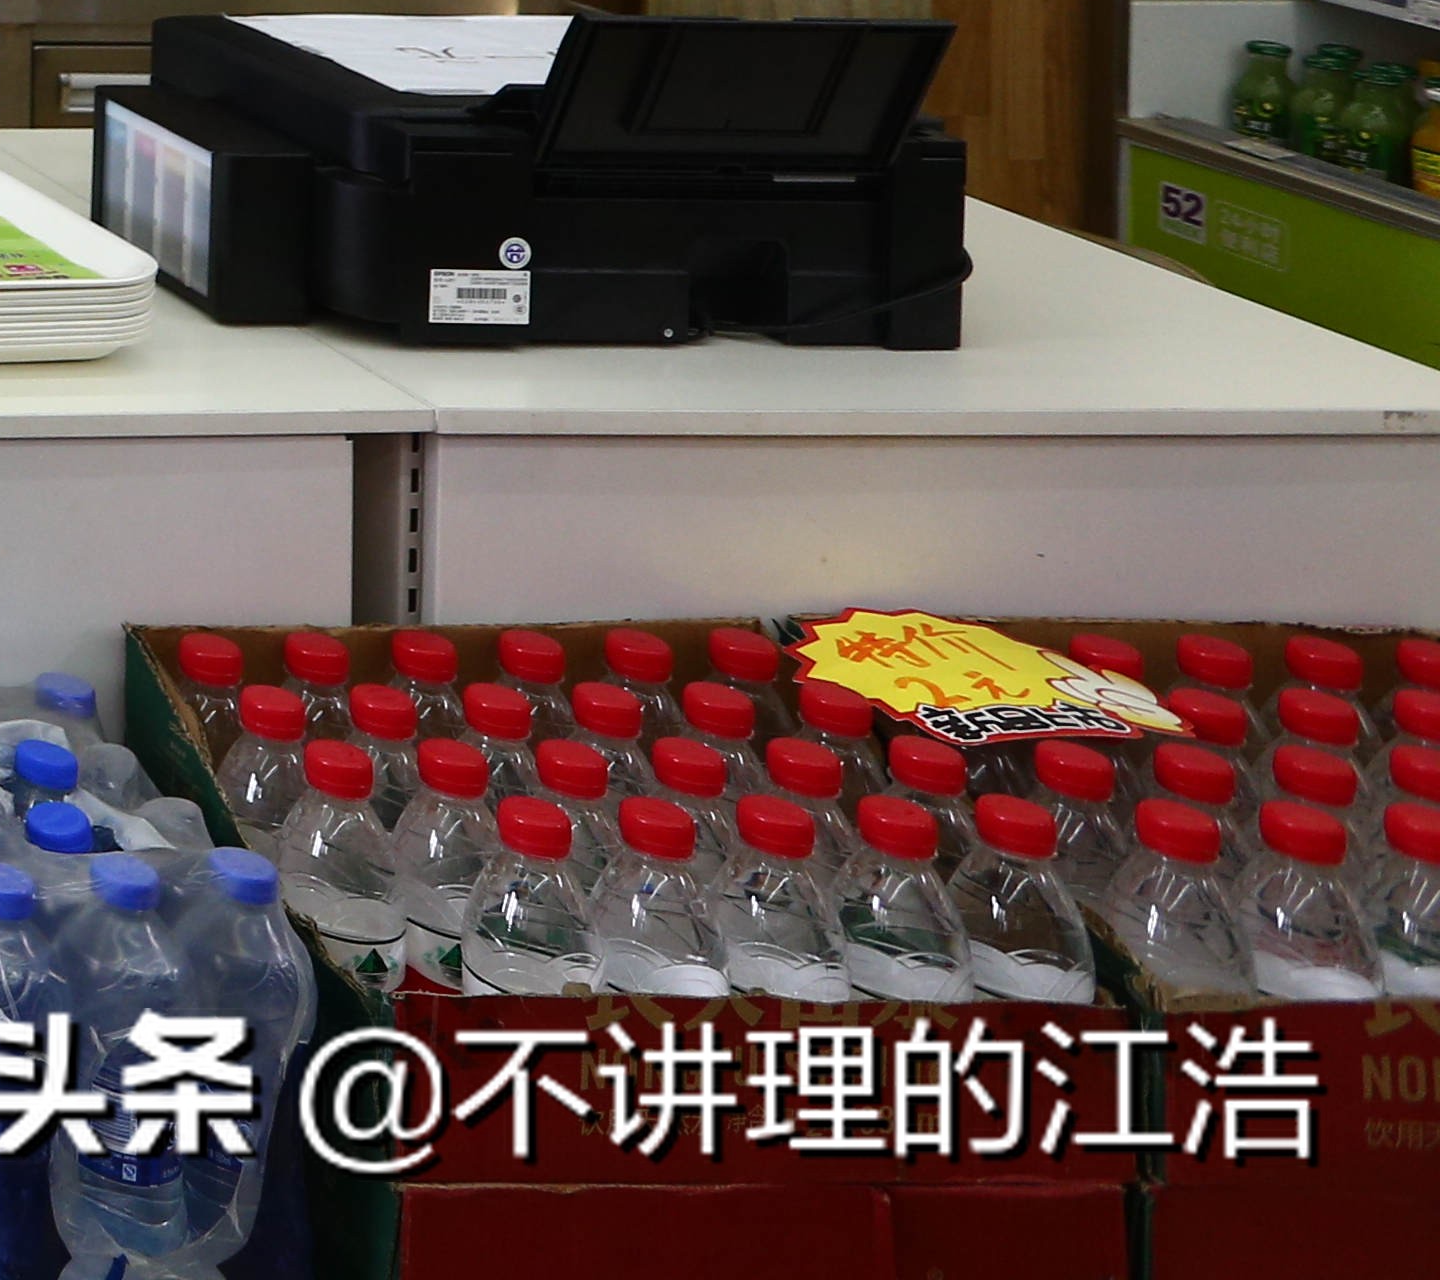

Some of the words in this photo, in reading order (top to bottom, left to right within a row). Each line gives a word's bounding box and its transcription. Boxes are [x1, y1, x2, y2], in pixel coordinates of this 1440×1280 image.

[1161, 183, 1205, 228] 52
[835, 623, 1017, 671] 特价
[894, 670, 1031, 708] 2元
